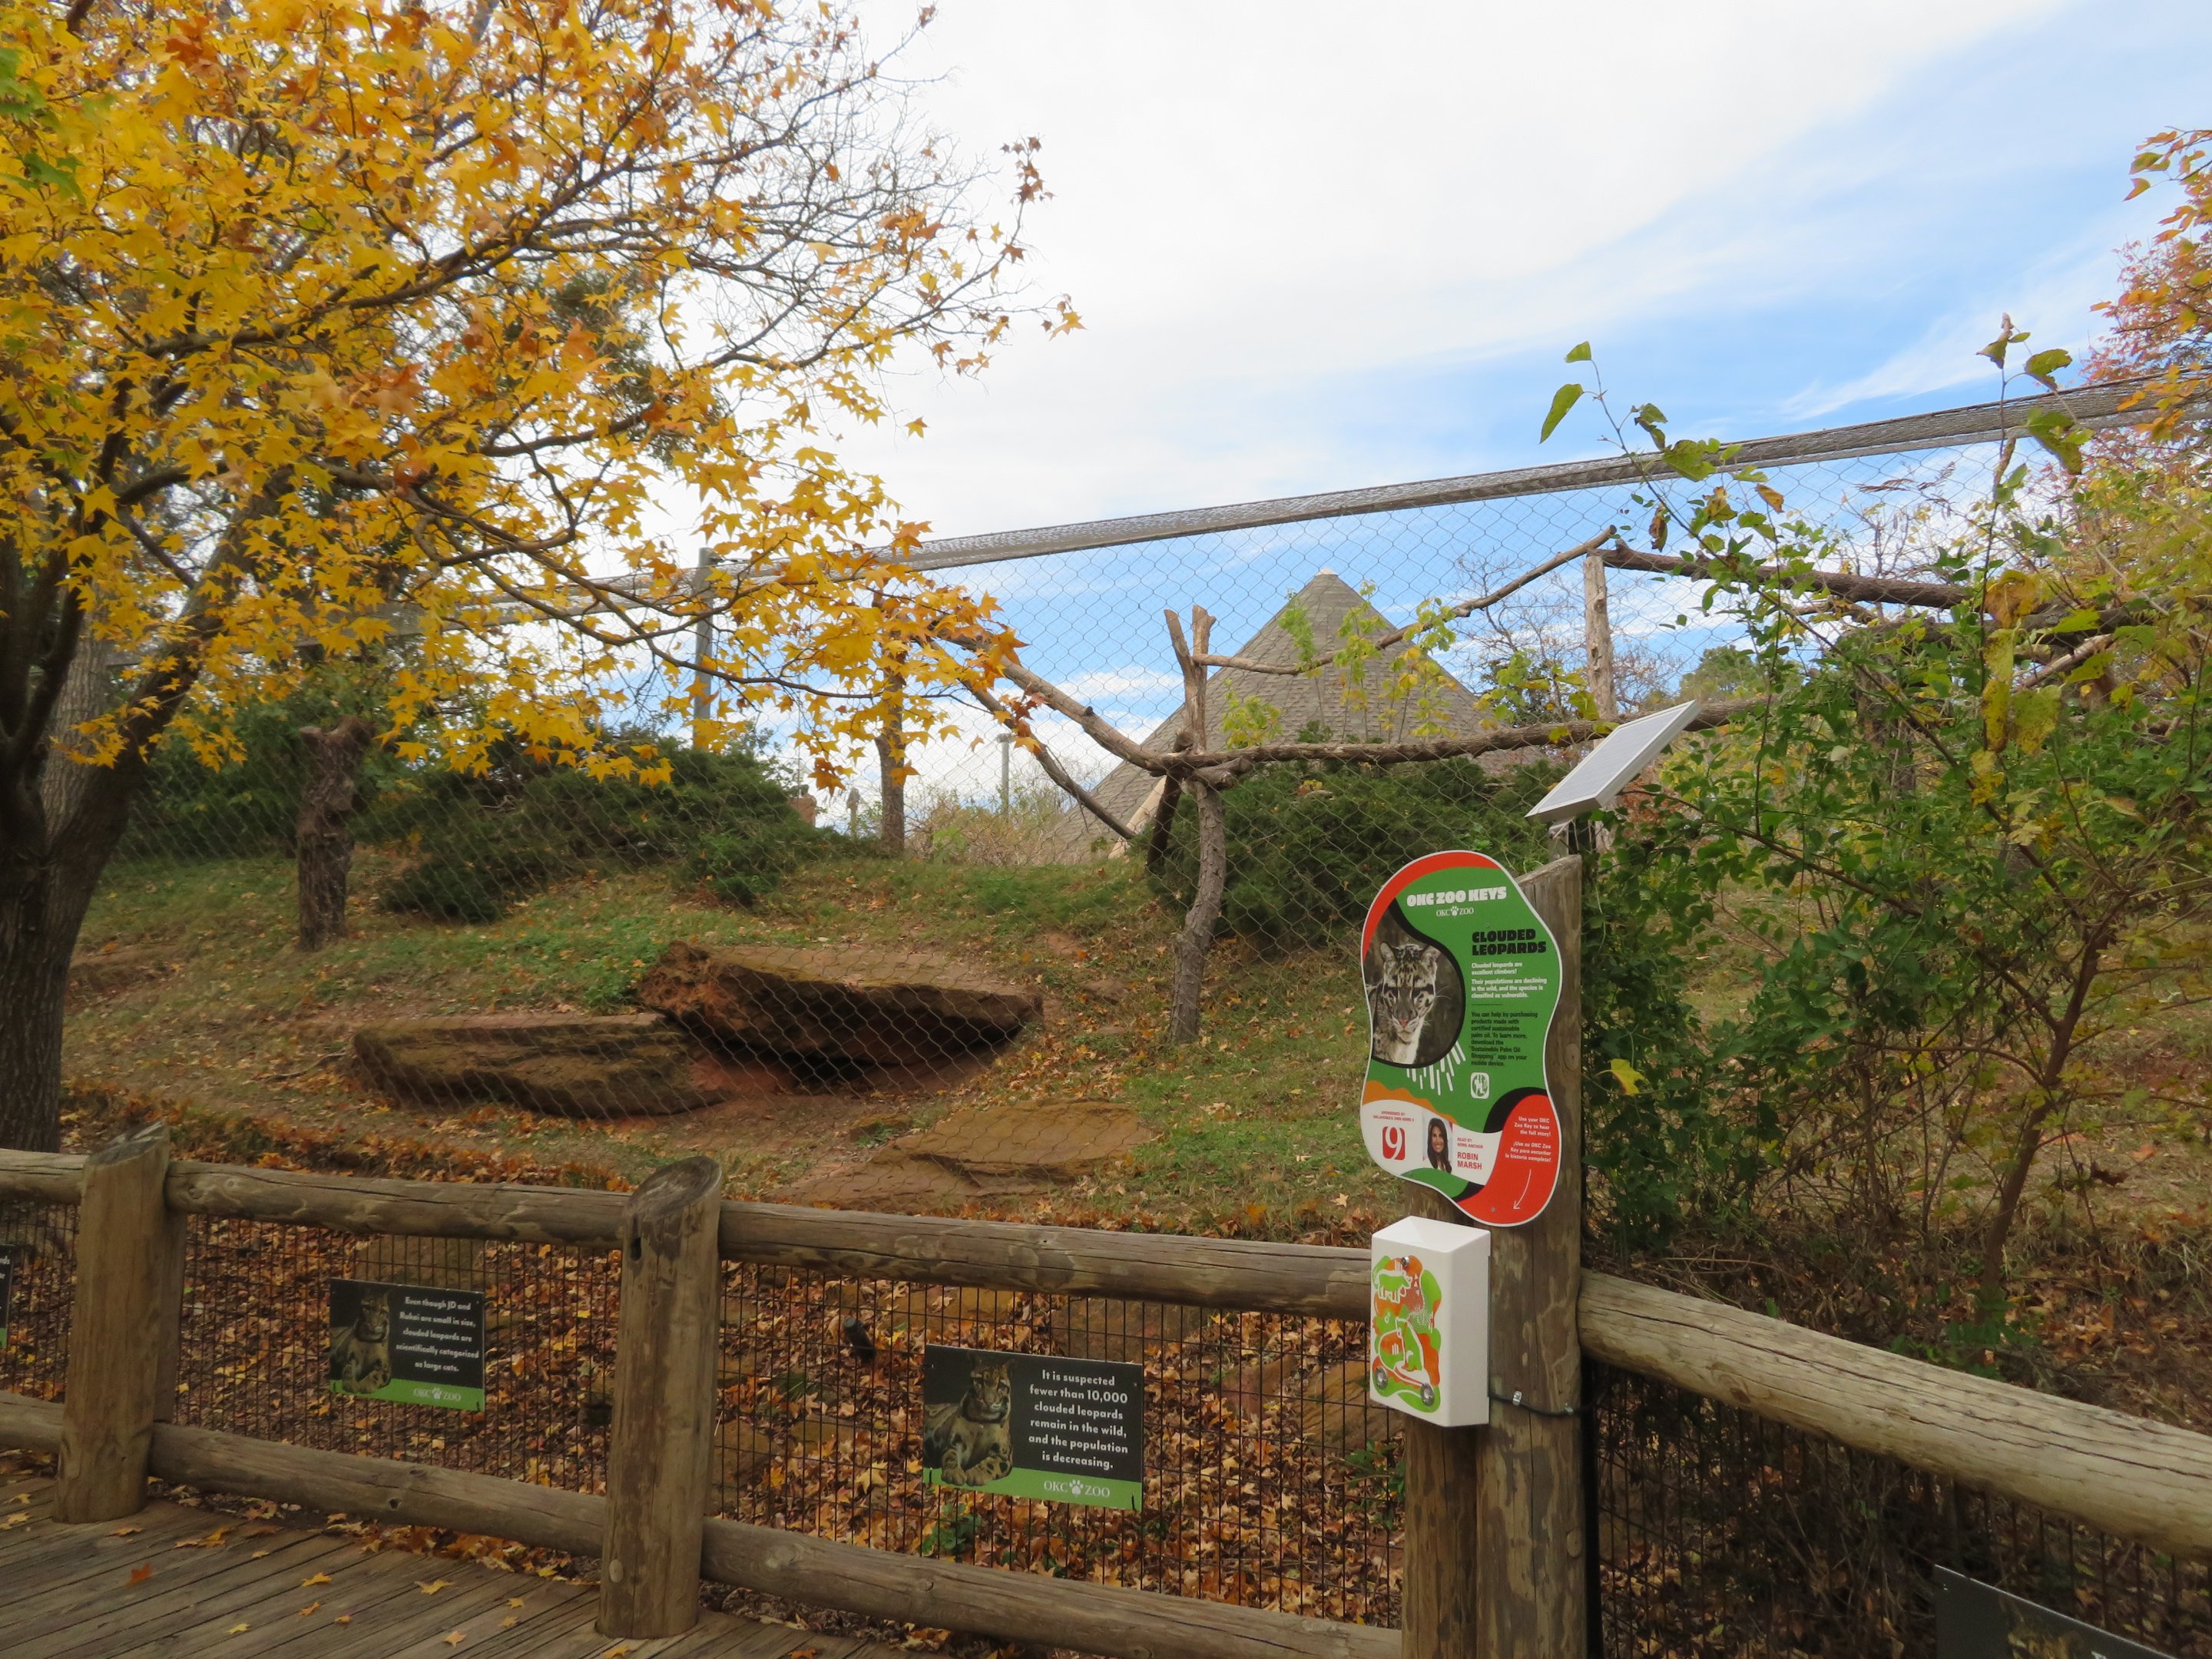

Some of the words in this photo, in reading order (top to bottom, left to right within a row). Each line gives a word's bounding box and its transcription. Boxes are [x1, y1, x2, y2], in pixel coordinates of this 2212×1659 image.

[1407, 893, 1434, 906] OKC
[1436, 890, 1466, 904] ZOO
[1469, 886, 1506, 902] KEYS
[1472, 929, 1535, 943] CLOUDED
[1472, 942, 1546, 955] LEOPARDS
[1385, 1126, 1402, 1160] 9
[1457, 1152, 1479, 1161] ROBIN
[1457, 1161, 1482, 1170] MARSH
[406, 1296, 421, 1305] Even
[422, 1299, 446, 1309] though
[447, 1301, 456, 1310] JD
[461, 1319, 475, 1328] size,
[403, 1328, 429, 1337] clouded
[430, 1330, 459, 1341] leopards
[396, 1343, 438, 1356] scientifically
[439, 1348, 479, 1359] categorized
[424, 1361, 442, 1371] large
[1042, 1369, 1050, 1379] It
[1053, 1371, 1061, 1381] is
[1063, 1375, 1114, 1386] suspected
[443, 1391, 461, 1401] ZOO
[1030, 1384, 1058, 1397] fewer
[1060, 1388, 1084, 1399] than
[1087, 1390, 1128, 1403] 10,000
[1035, 1401, 1075, 1415] clouded
[1078, 1406, 1123, 1419] leopards
[1031, 1420, 1066, 1429] remain
[1070, 1422, 1079, 1431] in
[1082, 1422, 1098, 1433] the
[1101, 1426, 1127, 1439] wild,
[1029, 1434, 1048, 1444] and
[1051, 1435, 1067, 1446] the
[1070, 1439, 1128, 1453] population
[1042, 1451, 1050, 1460] is
[1053, 1452, 1114, 1471] decreasing.
[1044, 1481, 1068, 1492] OKC
[1085, 1485, 1110, 1497] ZOO
